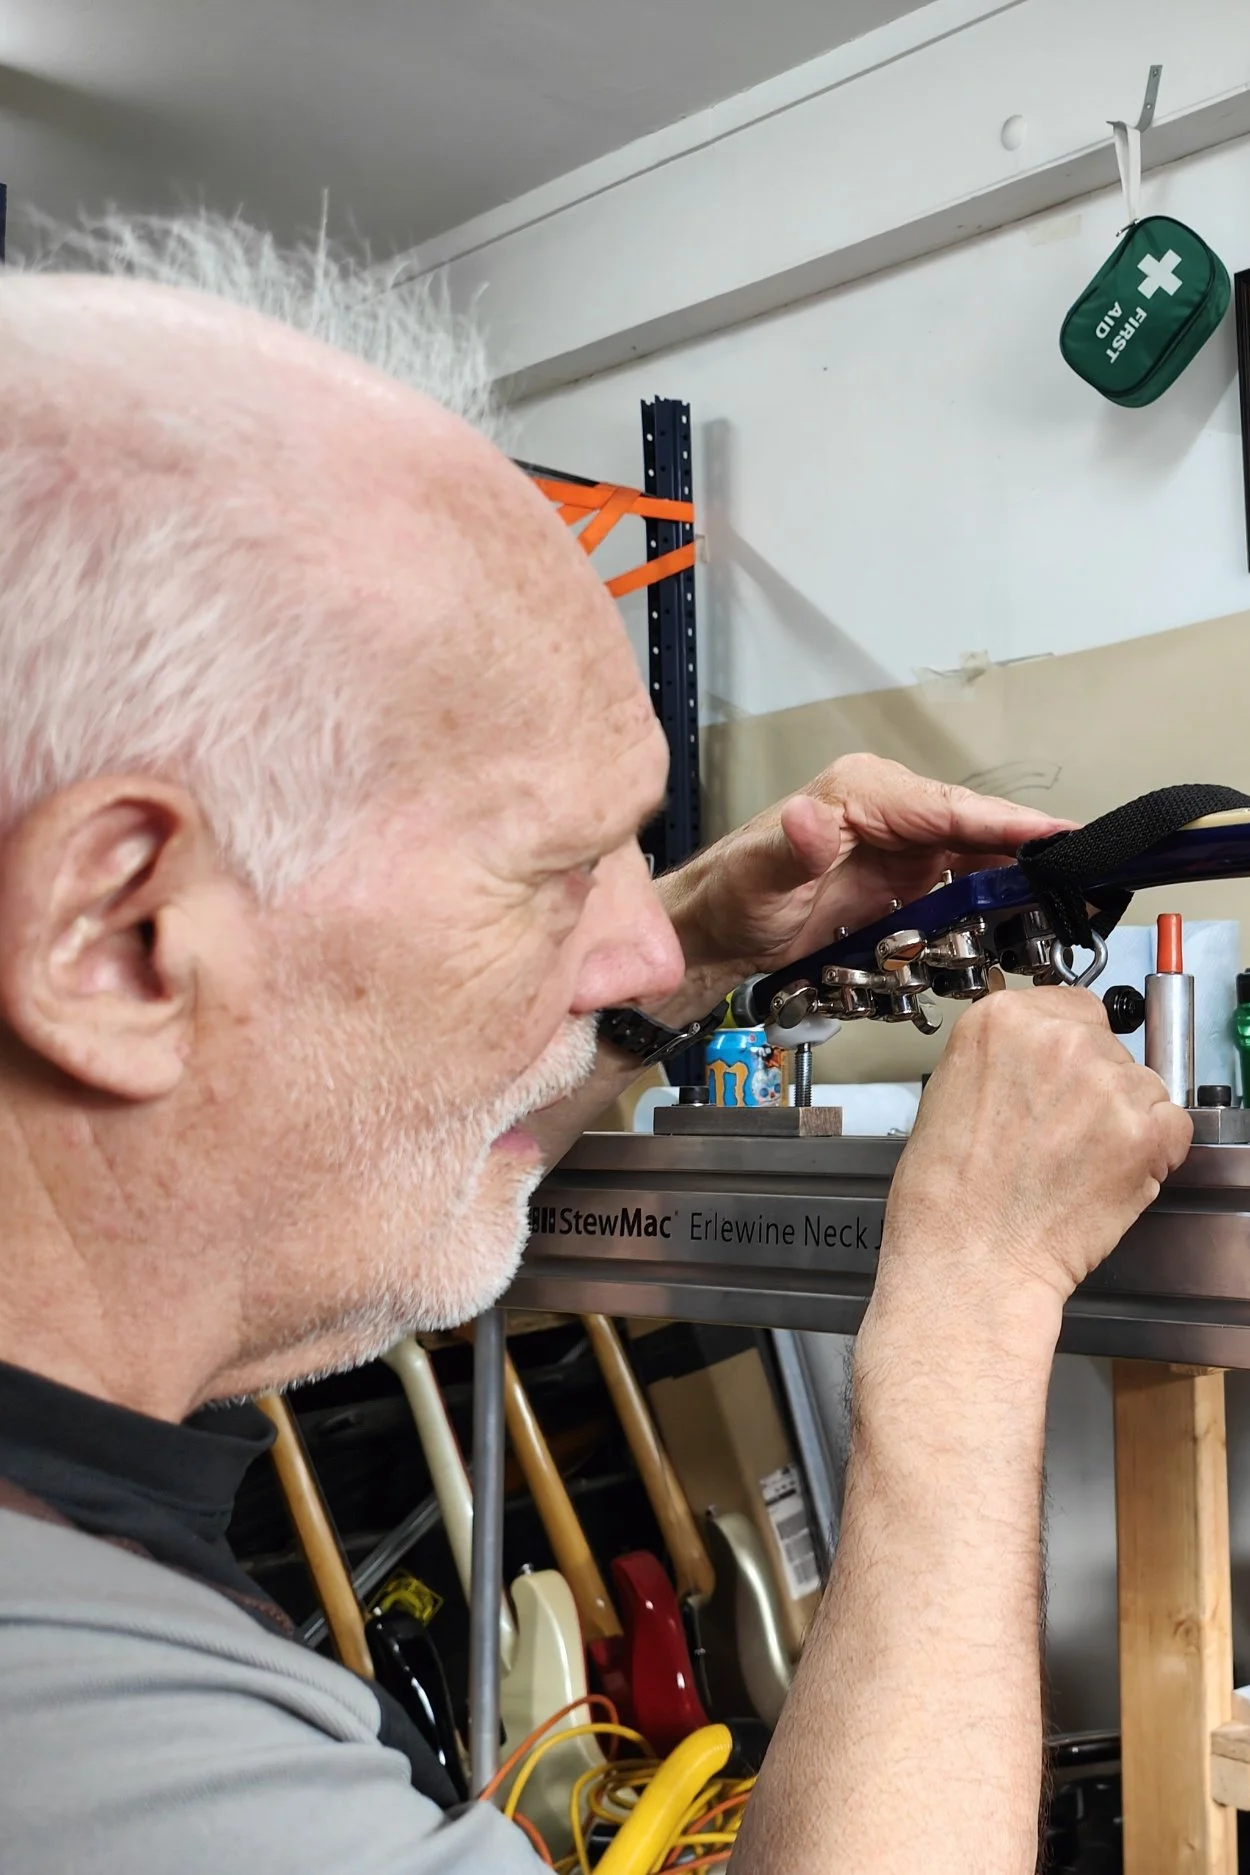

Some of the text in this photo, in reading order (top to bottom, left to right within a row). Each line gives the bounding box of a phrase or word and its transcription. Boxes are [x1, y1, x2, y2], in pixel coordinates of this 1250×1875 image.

[1095, 301, 1123, 339] AID
[1106, 306, 1147, 364] FIRST
[559, 1207, 672, 1239] StewMac
[690, 1212, 795, 1245] Erlewine
[804, 1215, 868, 1250] Neck
